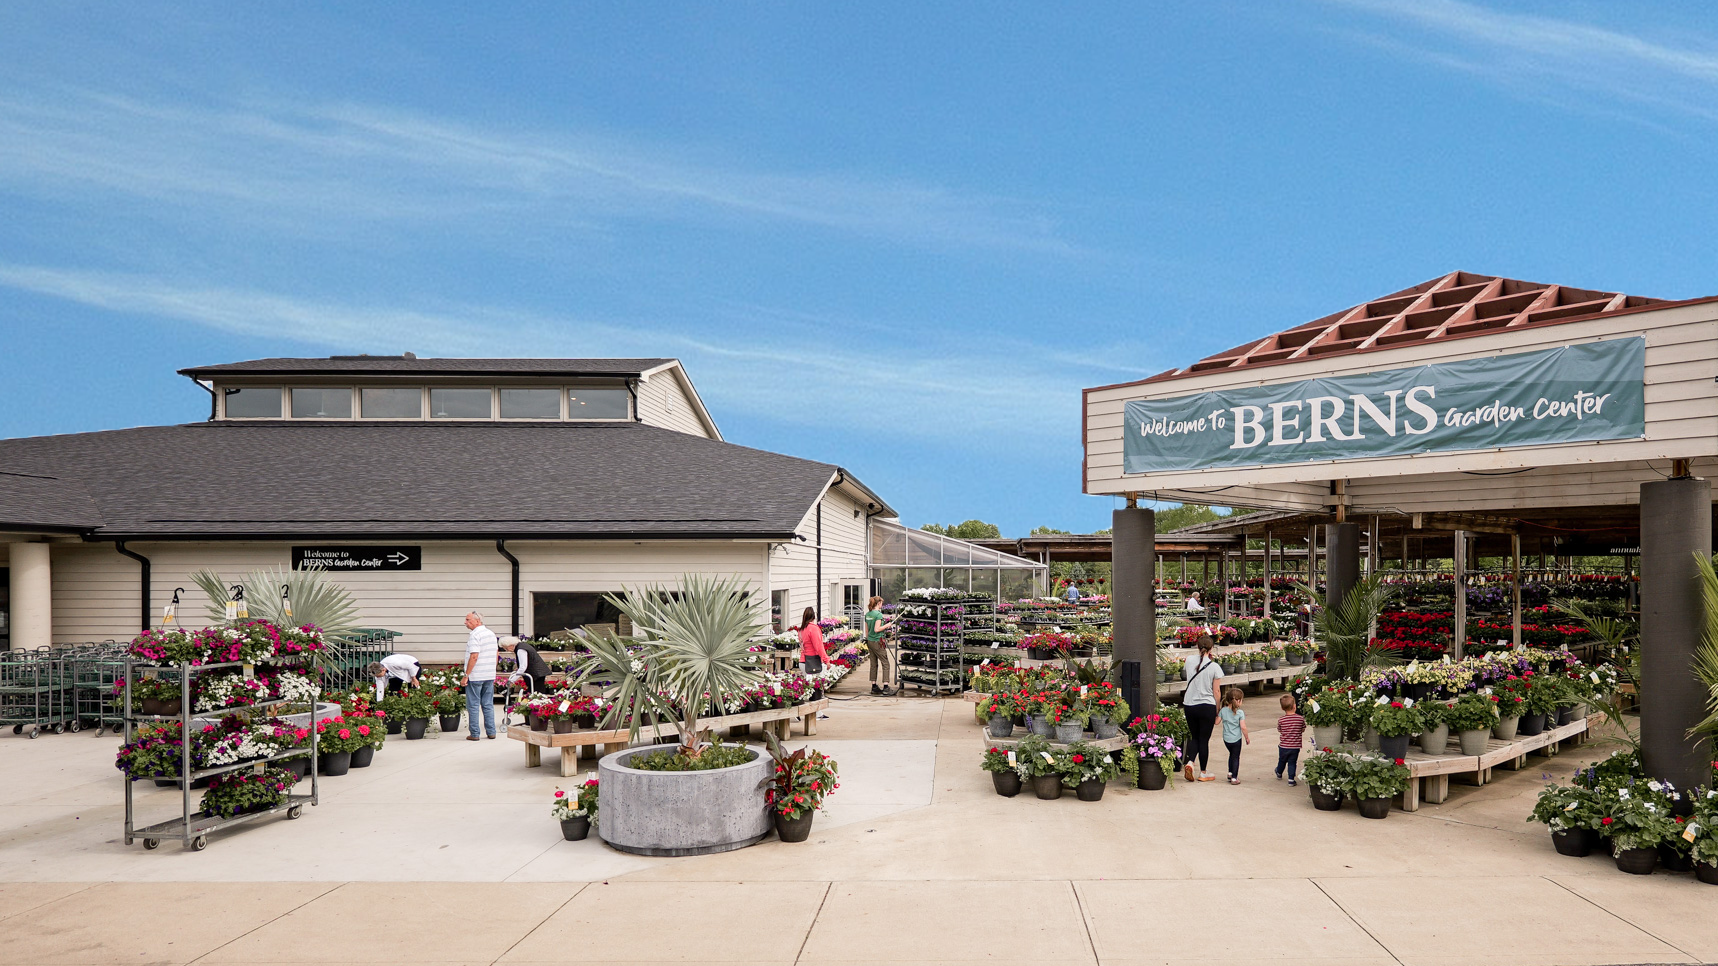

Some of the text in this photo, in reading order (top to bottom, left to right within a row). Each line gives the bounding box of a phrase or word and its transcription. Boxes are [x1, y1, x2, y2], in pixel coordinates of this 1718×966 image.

[1230, 385, 1438, 449] BERNS
[1443, 399, 1525, 428] Garden
[1532, 390, 1611, 420] Center
[304, 550, 340, 558] Welcome
[303, 558, 383, 568] BERNS Garden Center
